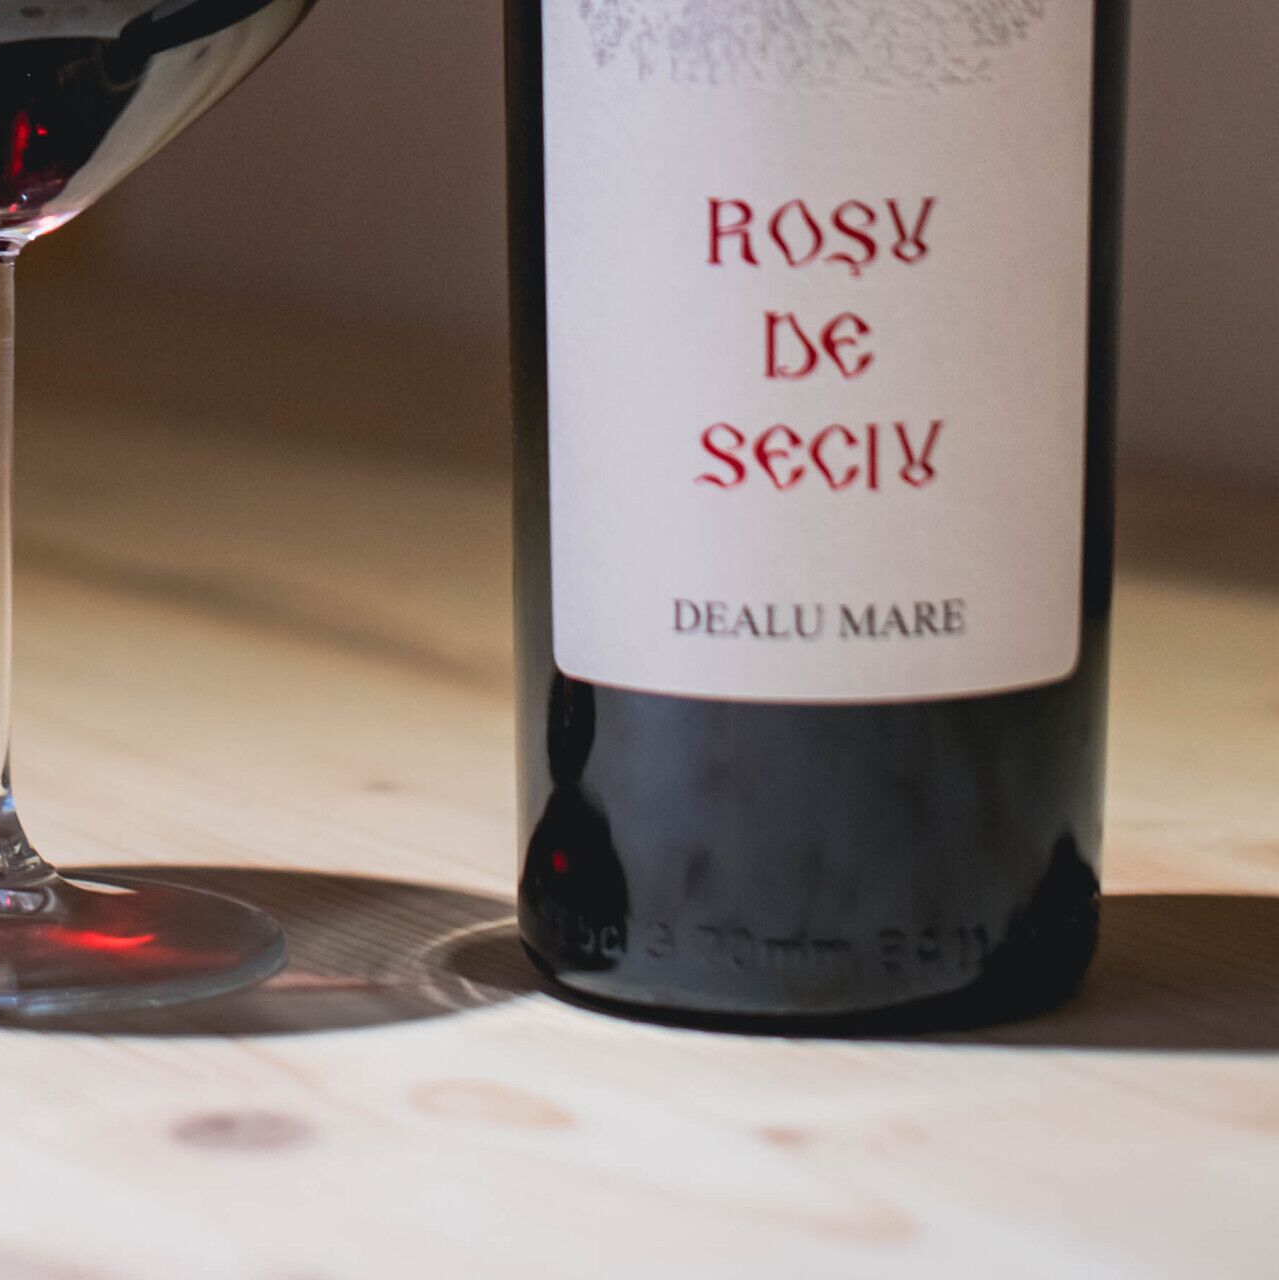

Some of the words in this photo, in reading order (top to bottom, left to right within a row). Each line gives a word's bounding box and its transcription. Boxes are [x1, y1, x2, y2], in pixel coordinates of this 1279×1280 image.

[762, 309, 875, 381] DE
[673, 598, 824, 640] DEALU
[839, 598, 966, 640] MARE
